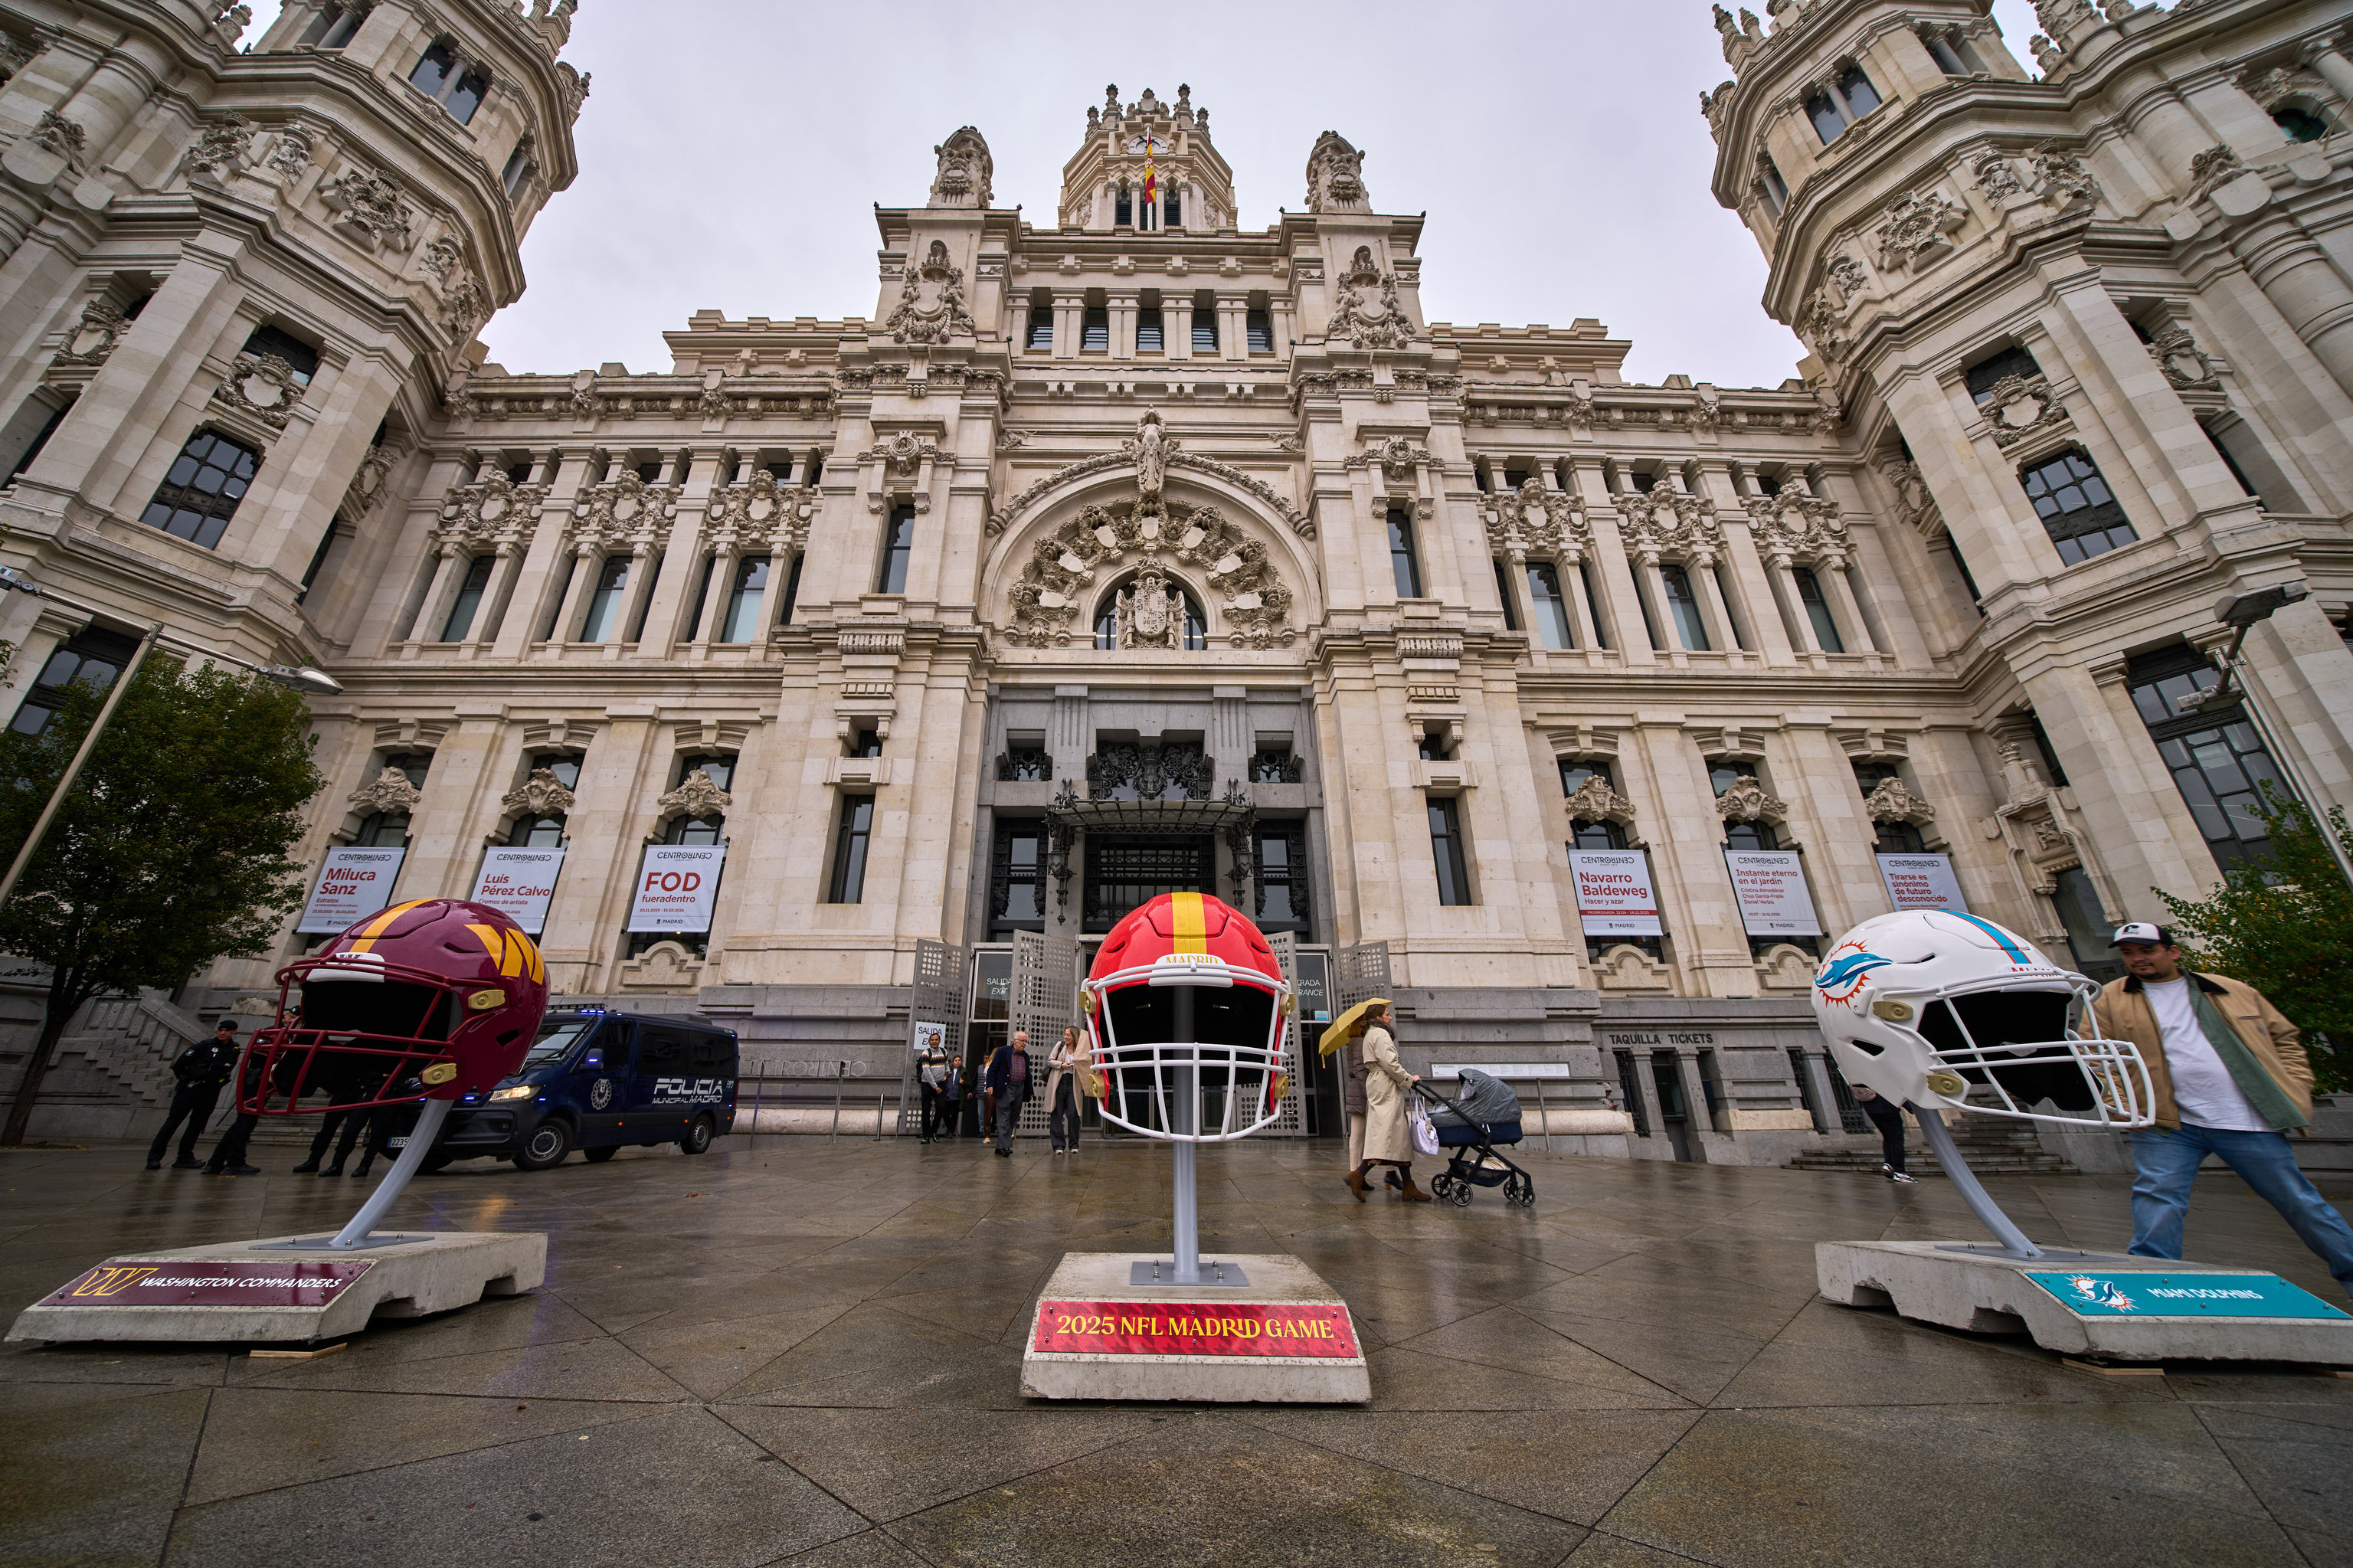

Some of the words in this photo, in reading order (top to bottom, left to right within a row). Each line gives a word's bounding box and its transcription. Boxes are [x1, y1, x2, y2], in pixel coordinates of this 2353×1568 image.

[326, 868, 376, 881] Miluca
[485, 873, 509, 884] Luis
[1579, 872, 1632, 883] Navarro
[644, 872, 701, 892] FOD
[319, 882, 358, 895] Sanz
[481, 885, 515, 895] Pérez
[517, 885, 551, 896] Calvo
[1582, 885, 1648, 899] Baldeweg
[642, 894, 695, 903] fueradentro
[987, 977, 1011, 986] SALIDA
[918, 1026, 942, 1036] SALIDA
[1608, 1034, 1661, 1045] TAQUILLA
[1667, 1033, 1713, 1044] TICKETS
[689, 1095, 722, 1104] MADRID
[139, 1277, 236, 1288] WASHINGTON
[238, 1277, 343, 1288] COMMANDERS
[2146, 1288, 2195, 1298] MIAMI
[2188, 1288, 2264, 1300] DOLPHINS
[1056, 1314, 1115, 1335] 2025
[1121, 1316, 1163, 1336] NFL
[1168, 1318, 1260, 1339] MADRID
[1265, 1318, 1334, 1339] GAME
